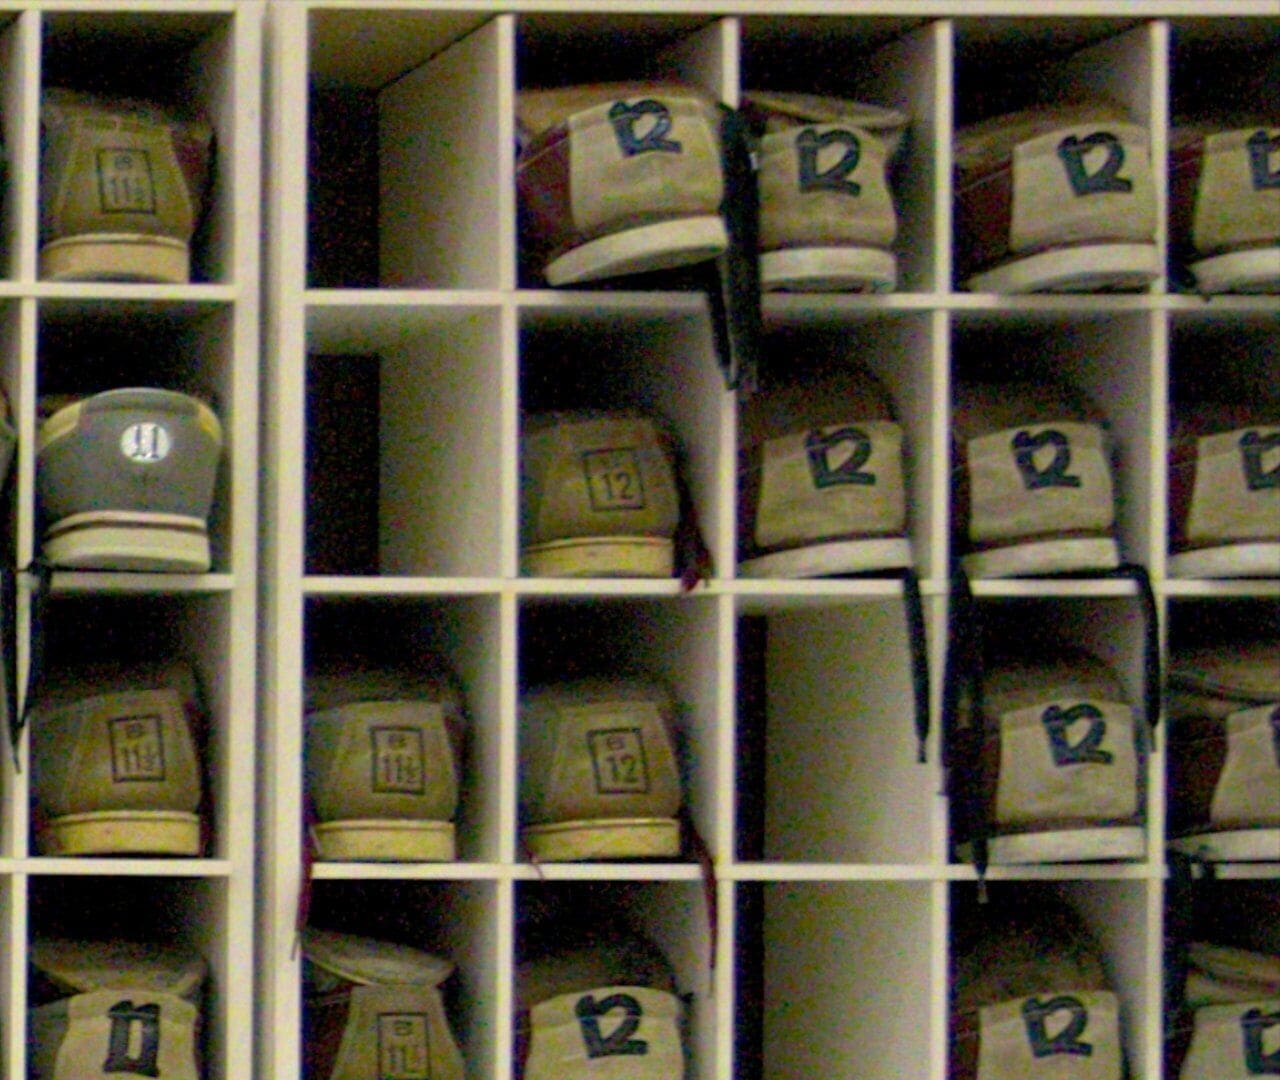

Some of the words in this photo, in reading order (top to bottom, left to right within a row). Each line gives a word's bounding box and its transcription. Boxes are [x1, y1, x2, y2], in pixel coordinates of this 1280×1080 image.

[608, 99, 682, 157] 12
[794, 126, 861, 197] 12
[1057, 131, 1133, 197] 12
[601, 471, 634, 500] 12
[805, 425, 877, 489] 12
[1011, 428, 1081, 490] 12
[1041, 703, 1113, 766] 12
[607, 755, 638, 783] 12
[103, 1000, 161, 1078] 11
[574, 993, 648, 1058] 12
[1020, 995, 1093, 1058] 12
